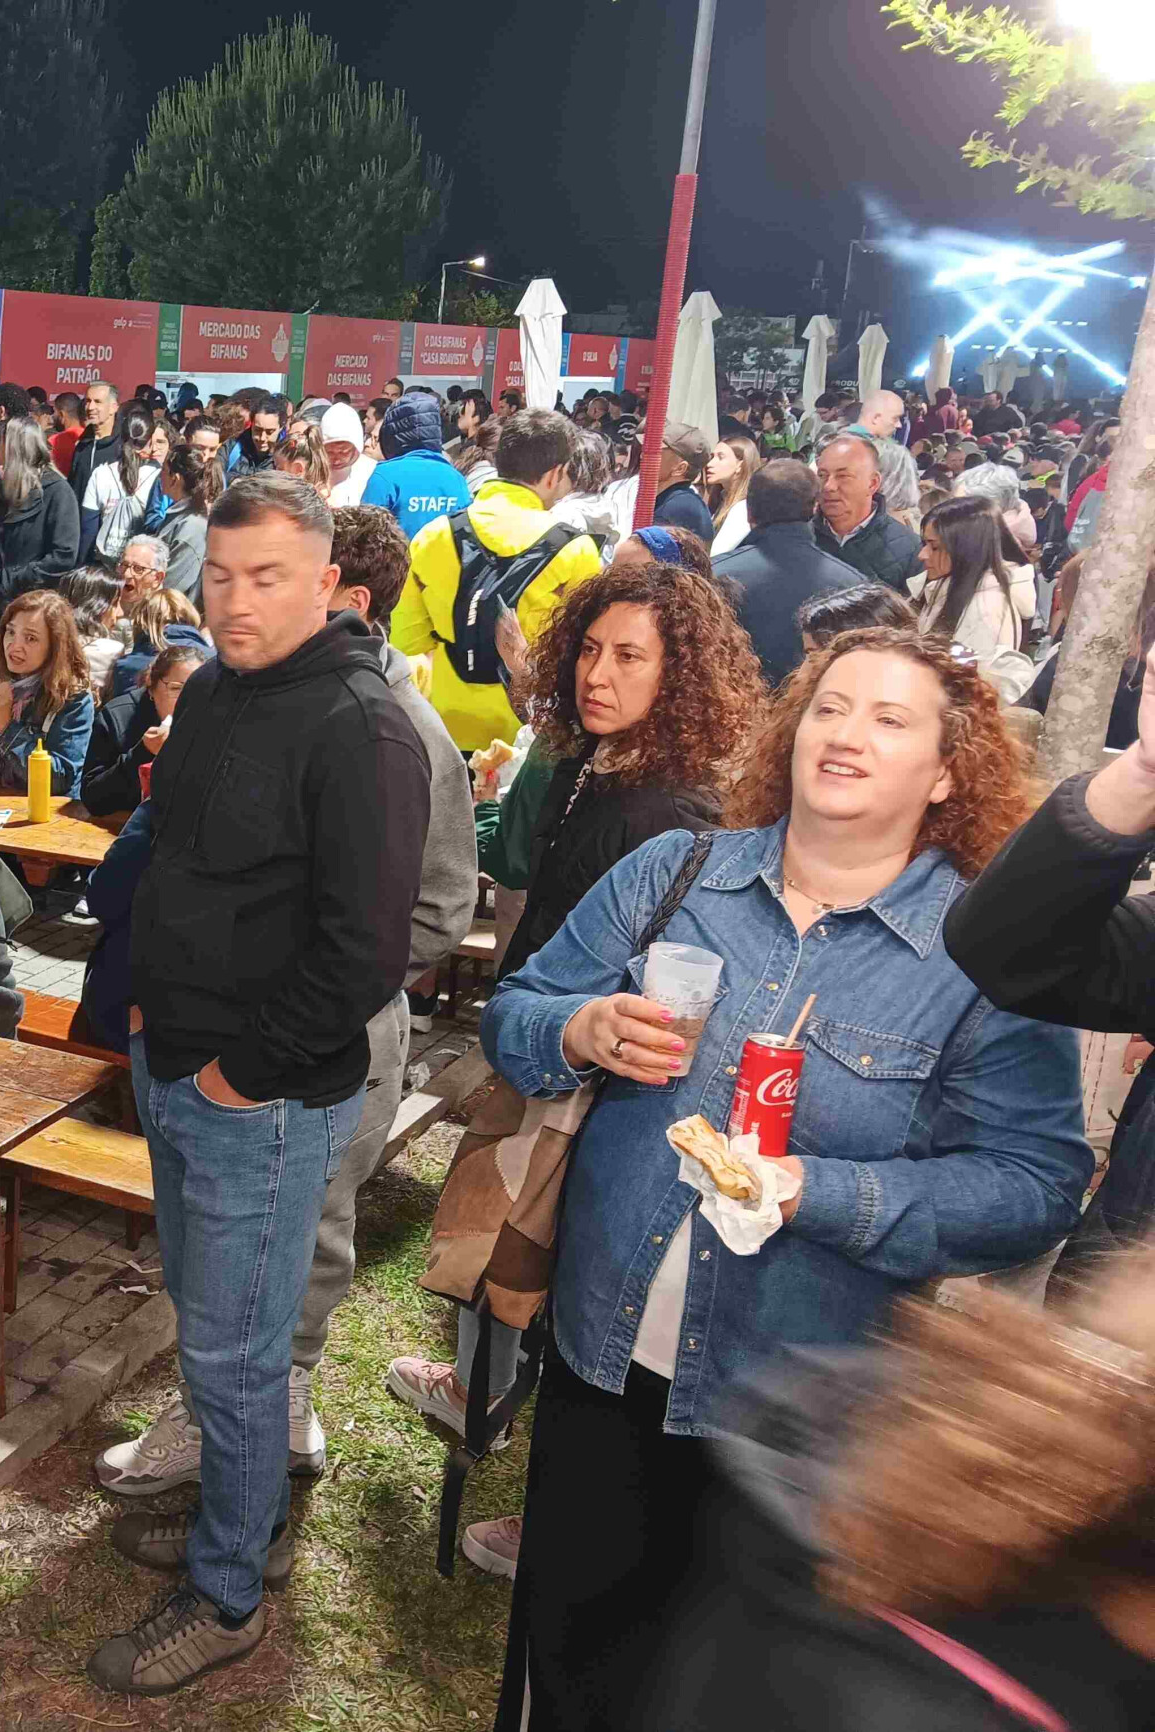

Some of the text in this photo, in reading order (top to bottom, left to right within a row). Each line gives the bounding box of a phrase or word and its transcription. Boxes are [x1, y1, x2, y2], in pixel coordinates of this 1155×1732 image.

[199, 321, 261, 340] MERCADO DAS
[47, 342, 113, 361] BIFANAS DO
[210, 343, 248, 360] BIFANAS
[334, 354, 369, 368] MERCADO
[56, 364, 100, 384] PATRÃO
[327, 373, 372, 386] DAS BIFANAS
[408, 496, 458, 513] STAFF
